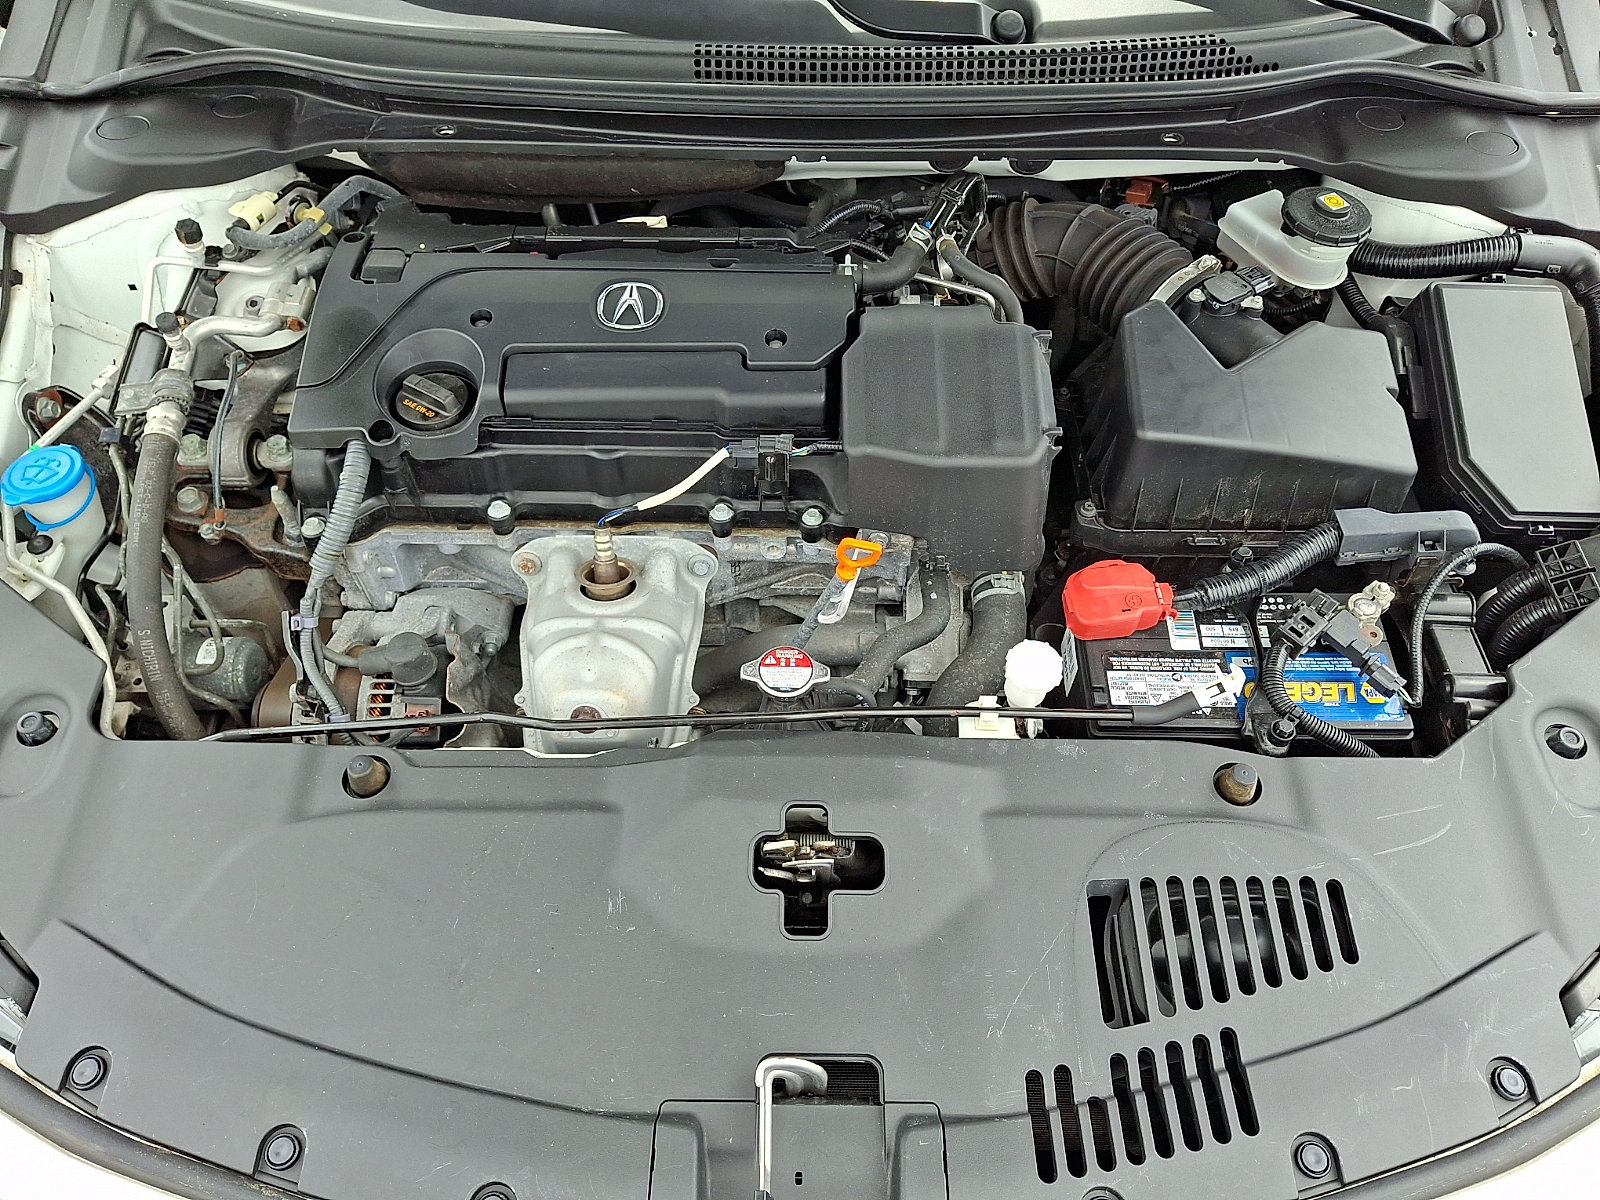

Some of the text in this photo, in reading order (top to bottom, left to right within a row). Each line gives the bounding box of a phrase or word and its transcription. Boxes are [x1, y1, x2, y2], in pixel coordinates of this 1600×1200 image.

[402, 399, 436, 418] SAE 0W-20
[1281, 680, 1358, 705] LEGE
